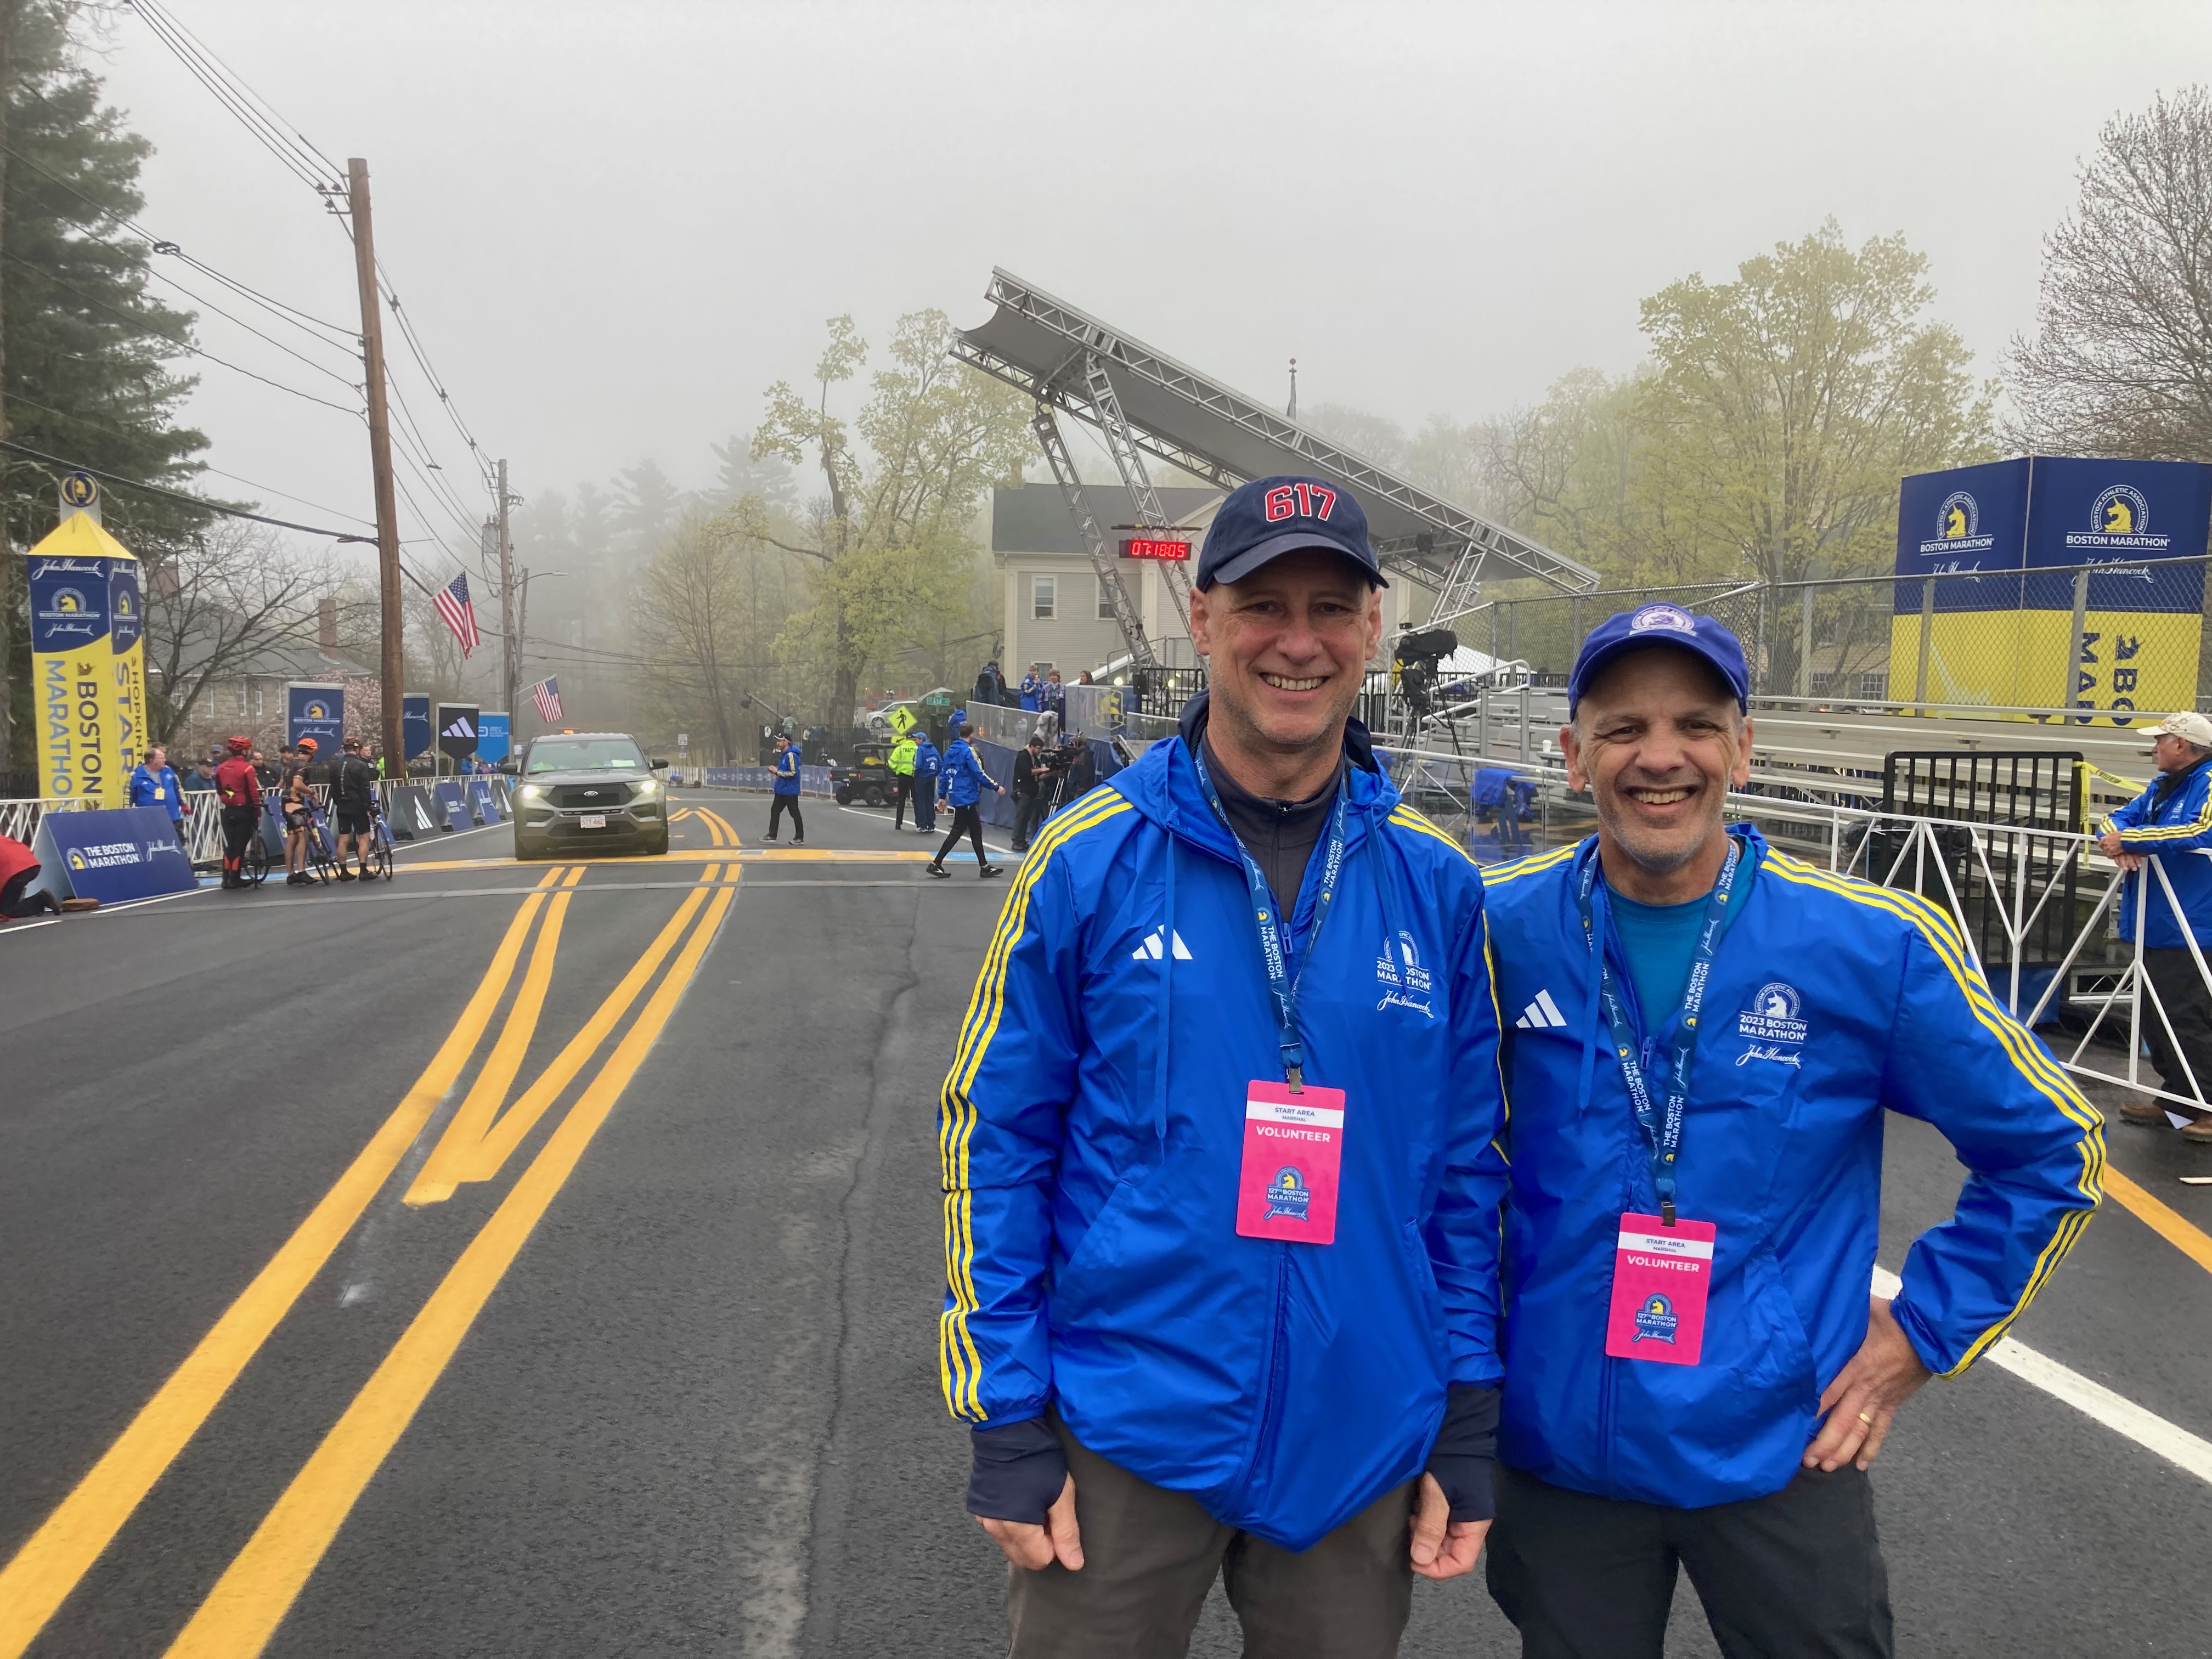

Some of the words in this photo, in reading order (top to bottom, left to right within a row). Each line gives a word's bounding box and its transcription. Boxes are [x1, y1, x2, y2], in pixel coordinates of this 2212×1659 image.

[1265, 483, 1336, 522] 617
[2093, 501, 2102, 529] BOSTON
[2102, 488, 2129, 502] ATHLETIC
[2129, 491, 2146, 531] ASSOCIATION
[1131, 541, 1186, 558] 07:18:05
[1920, 542, 1949, 552] BOSTON
[1950, 538, 1994, 549] MARATHON
[2066, 535, 2108, 544] BOSTON
[2111, 537, 2168, 546] MARATHON
[116, 662, 134, 775] STAR
[77, 682, 103, 794] BOSTON
[83, 845, 103, 856] THE
[102, 843, 136, 855] BOSTON
[88, 853, 140, 868] MARATHON
[1323, 870, 1331, 884] THE
[1327, 838, 1339, 870] BOSTON
[1328, 842, 1344, 889] MARATHON
[1718, 871, 1728, 886] THE
[1268, 926, 1277, 943] THE
[1260, 927, 1277, 980] MARATHON
[1271, 942, 1284, 978] BOSTON
[1376, 961, 1395, 972] 2023
[1406, 967, 1429, 981] OSTON
[1684, 994, 1694, 1010] THE
[1690, 962, 1703, 994] BOSTON
[1692, 963, 1710, 1013] MARATHON
[1377, 989, 1400, 1011] John
[1739, 1024, 1806, 1041] MARATHON
[1740, 1015, 1765, 1026] 2023
[1766, 1019, 1807, 1031] BOSTON
[1735, 1043, 1764, 1066] John
[1763, 1047, 1802, 1069] Hancock
[1629, 1060, 1640, 1076] THE
[1622, 1062, 1645, 1113] MARATHON
[1634, 1076, 1651, 1111] BOSTON
[1666, 1095, 1677, 1131] BOSTON
[1670, 1096, 1685, 1148] MARATHON
[1256, 1126, 1330, 1143] VOLUNTEER
[1663, 1130, 1672, 1147] THE
[1267, 1194, 1309, 1203] MARATHON
[1283, 1189, 1309, 1197] BOSTON
[1627, 1255, 1700, 1272] VOLUNTEER
[1636, 1318, 1677, 1328] MARATHON
